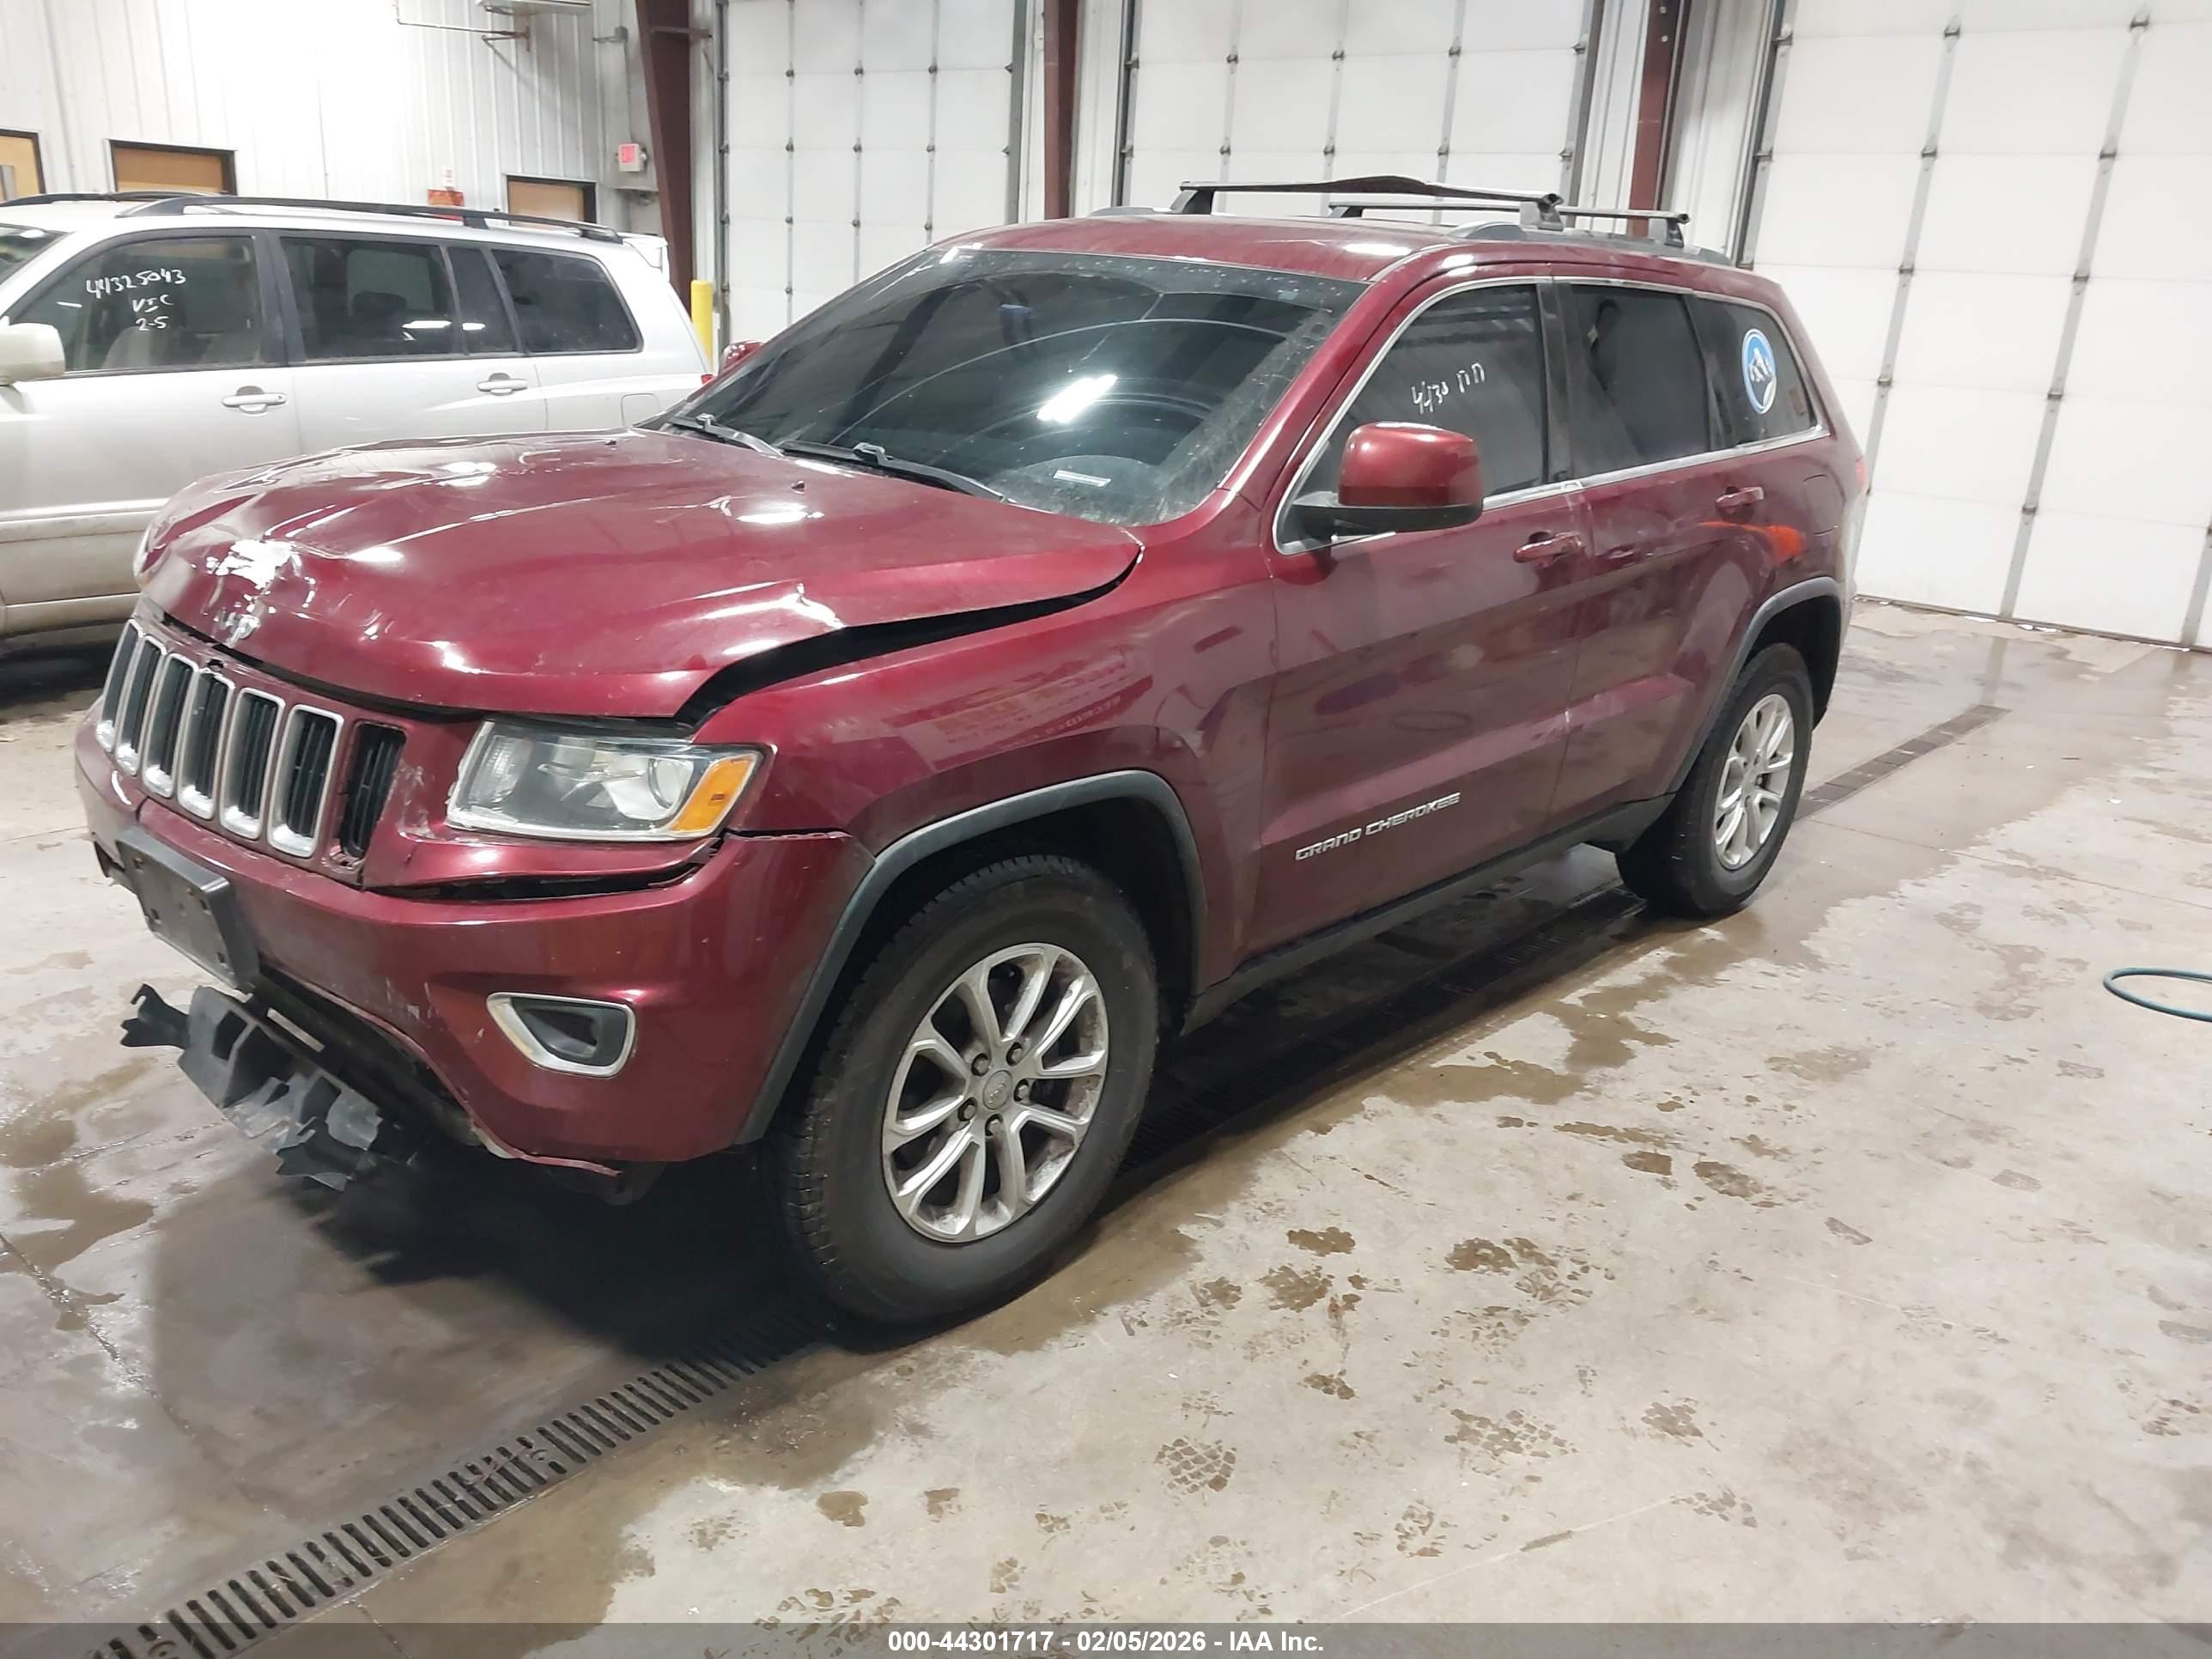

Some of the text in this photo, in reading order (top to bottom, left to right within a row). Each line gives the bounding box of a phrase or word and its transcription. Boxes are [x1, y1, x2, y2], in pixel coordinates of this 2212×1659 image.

[85, 267, 186, 300] 44325043
[135, 316, 170, 331] 2-5
[1294, 792, 1462, 861] GRAND CHEROKEE
